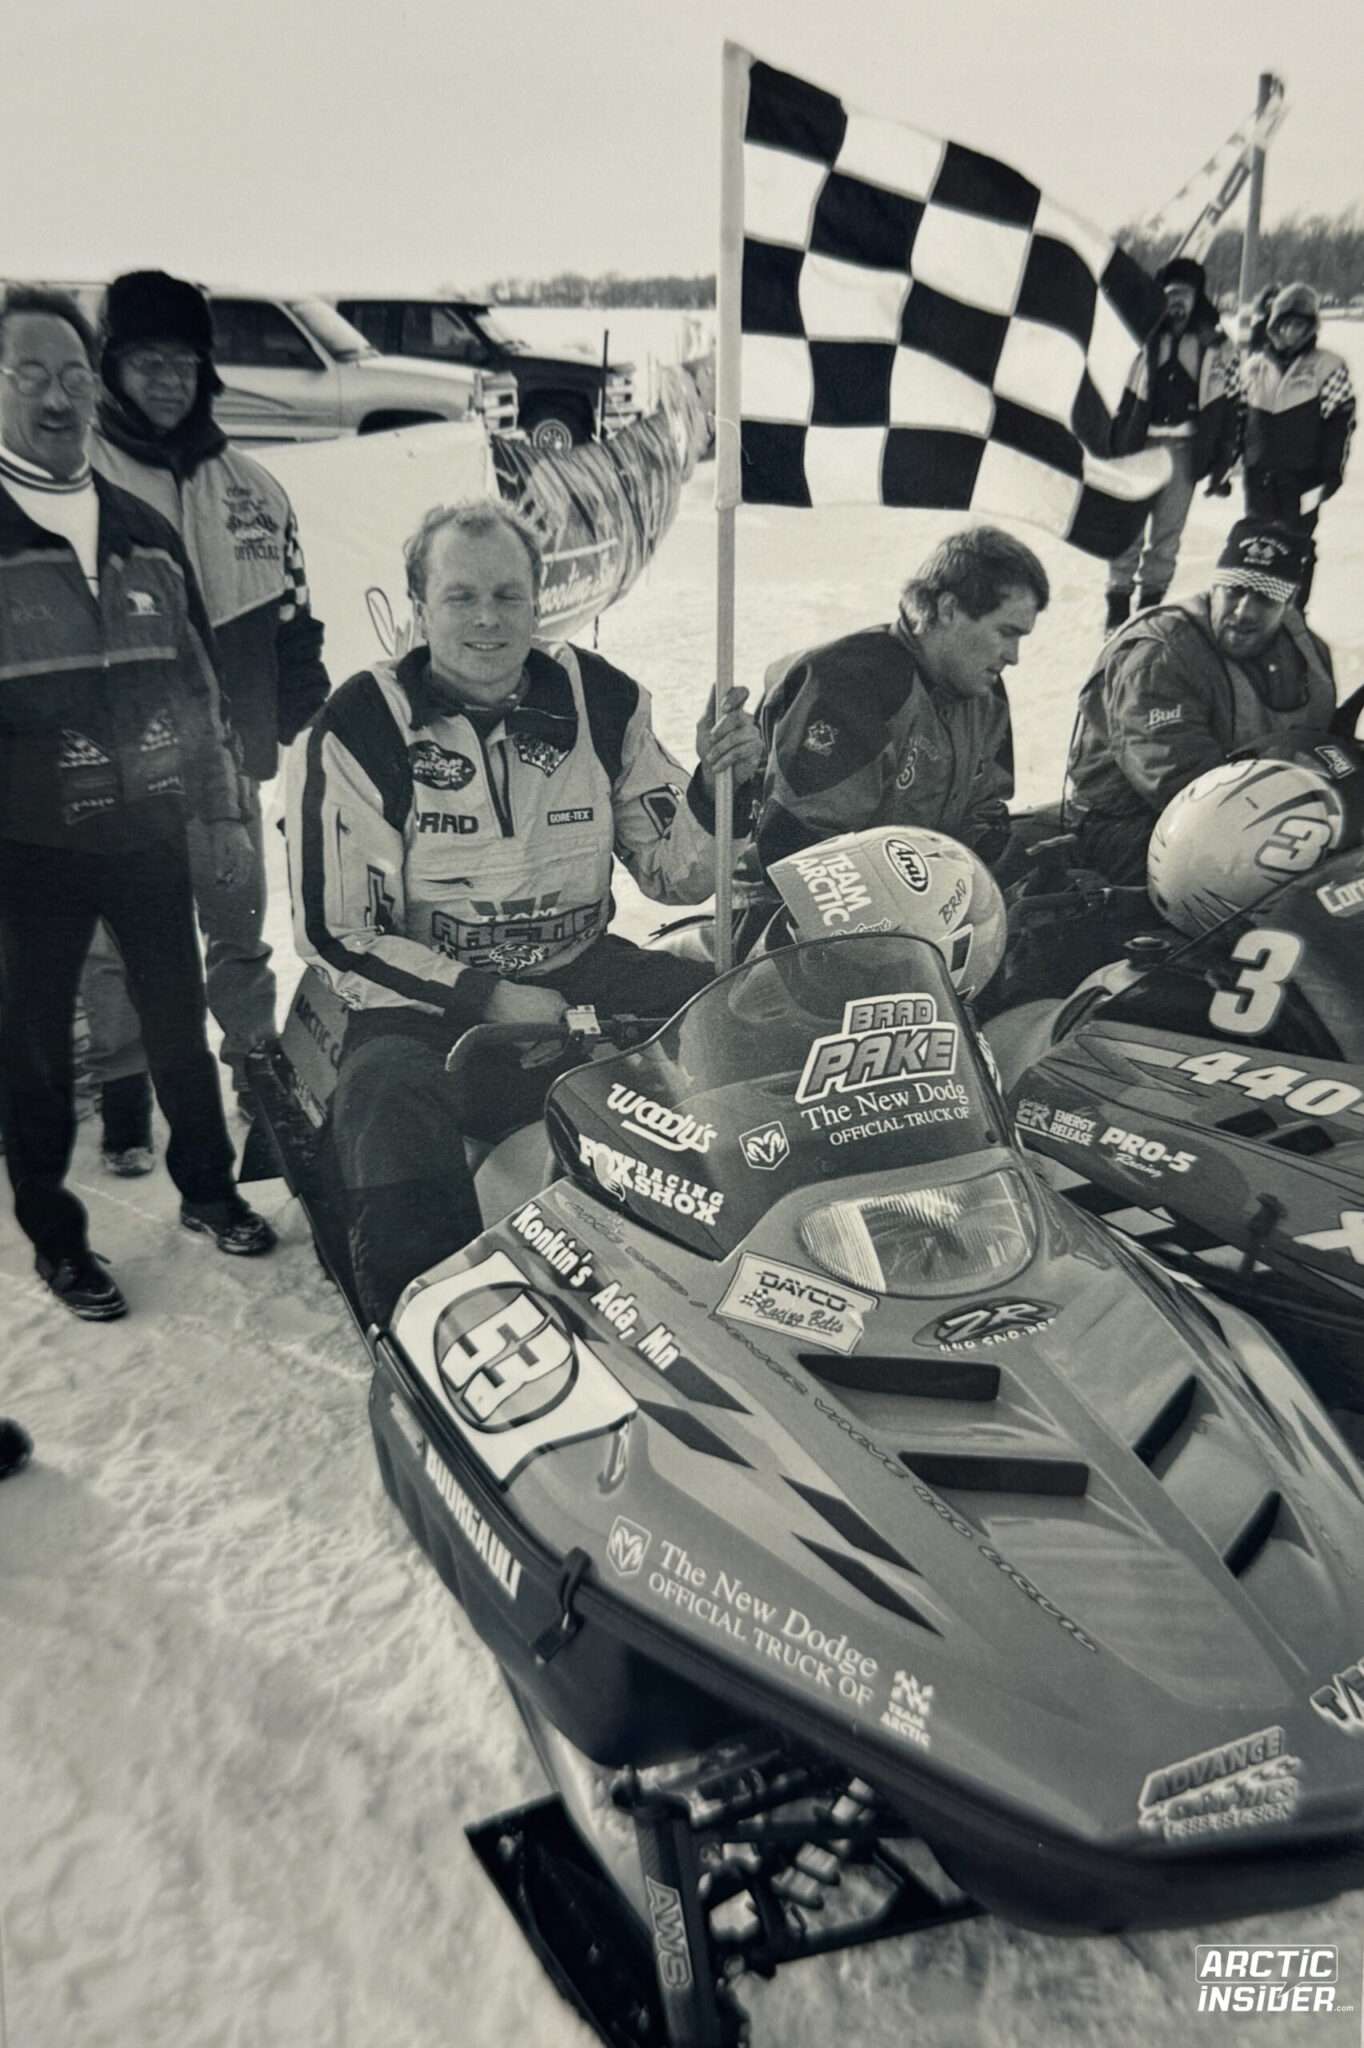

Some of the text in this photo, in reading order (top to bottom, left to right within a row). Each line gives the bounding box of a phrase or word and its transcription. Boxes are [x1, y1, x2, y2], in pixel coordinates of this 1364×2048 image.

[1149, 705, 1182, 725] Bud
[417, 812, 480, 834] RAD
[550, 809, 590, 823] GORE-TEX
[886, 840, 928, 889] Arai
[1256, 815, 1334, 874] 3
[789, 856, 850, 927] ARCTIC
[822, 853, 873, 913] TEAM
[938, 878, 968, 925] BRAD
[1208, 929, 1304, 1034] 3
[848, 1000, 934, 1034] BRAD
[802, 1027, 956, 1098] PAKE
[1177, 1050, 1363, 1116] 440
[607, 1083, 718, 1154] Woody's
[800, 1079, 969, 1131] The New Dodg
[829, 1106, 970, 1146] OFFICIAL TRUCK OF
[1053, 1109, 1097, 1132] ENERGY
[1048, 1121, 1094, 1147] RELEASE
[1099, 1126, 1198, 1173] PRO-5
[578, 1134, 637, 1193] FOX
[635, 1161, 725, 1207] RACING
[634, 1174, 721, 1227] SHOX
[512, 1203, 593, 1288] Konkin's
[590, 1281, 638, 1340] Ada,
[638, 1323, 680, 1371] Mn
[758, 1270, 848, 1313] DAYCO
[755, 1298, 845, 1333] Racing Belts
[440, 1291, 572, 1422] 53
[660, 1540, 878, 1678] The New Dodge
[648, 1571, 875, 1706] OFFICIAL TRUCK OF
[647, 1877, 691, 1987] AWS
